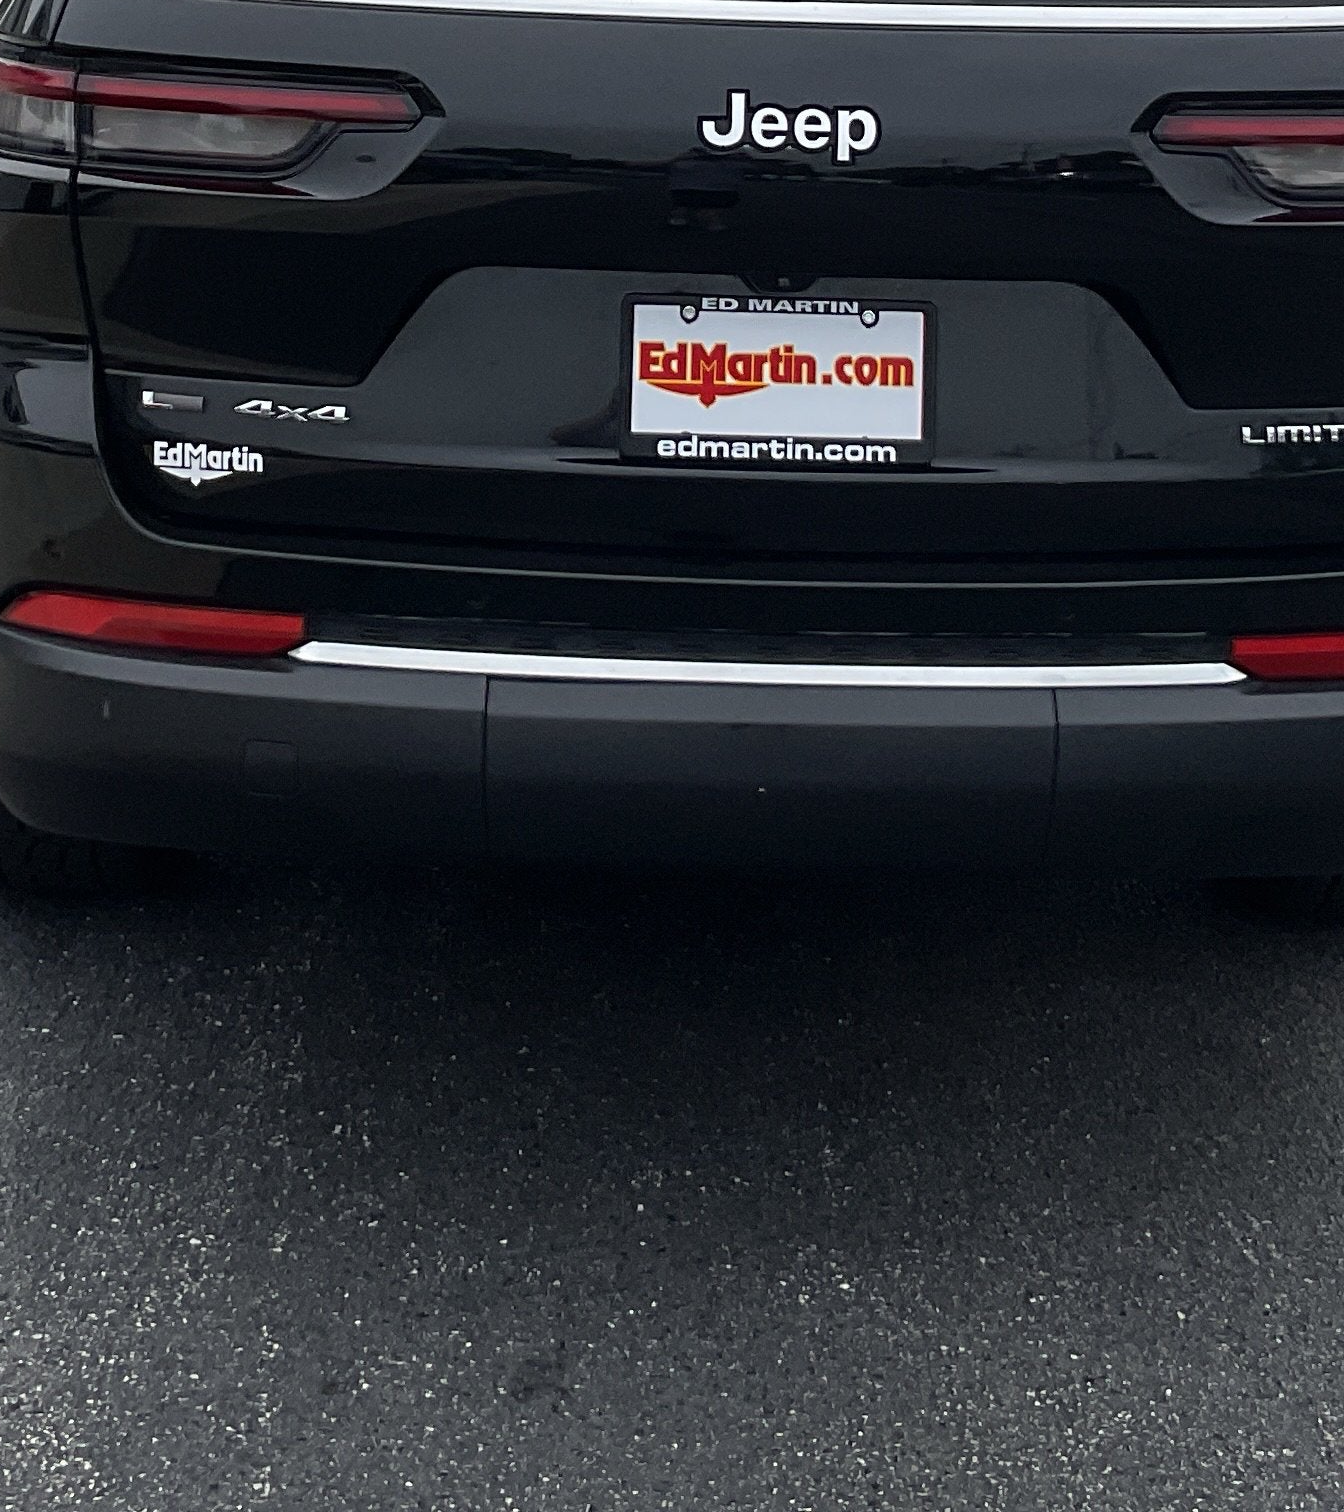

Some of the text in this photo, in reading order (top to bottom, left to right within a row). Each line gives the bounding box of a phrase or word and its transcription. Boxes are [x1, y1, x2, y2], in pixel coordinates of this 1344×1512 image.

[701, 92, 878, 162] Jeep
[701, 297, 859, 314] ED MARTIN
[639, 342, 915, 389] EdMartin.com
[233, 399, 350, 423] 4x4
[153, 440, 264, 473] EdMartin
[657, 436, 897, 462] edmartin.com
